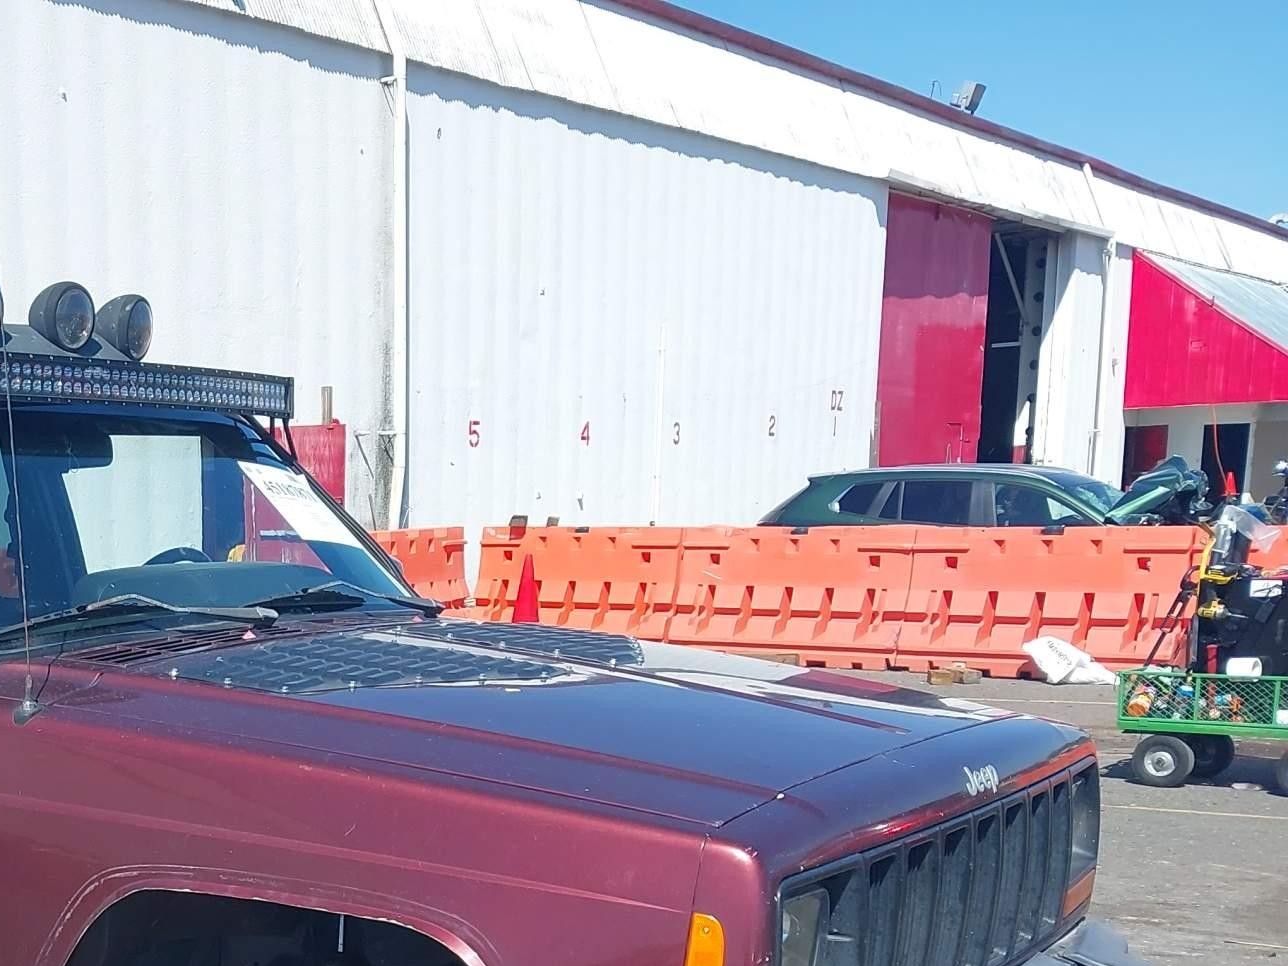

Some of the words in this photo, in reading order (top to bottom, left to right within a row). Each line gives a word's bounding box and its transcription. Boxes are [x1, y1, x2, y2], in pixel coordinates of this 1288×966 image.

[468, 420, 480, 448] 5
[580, 421, 590, 447] 4
[673, 422, 681, 445] 3
[768, 415, 776, 437] 2
[963, 764, 999, 796] Jeep
